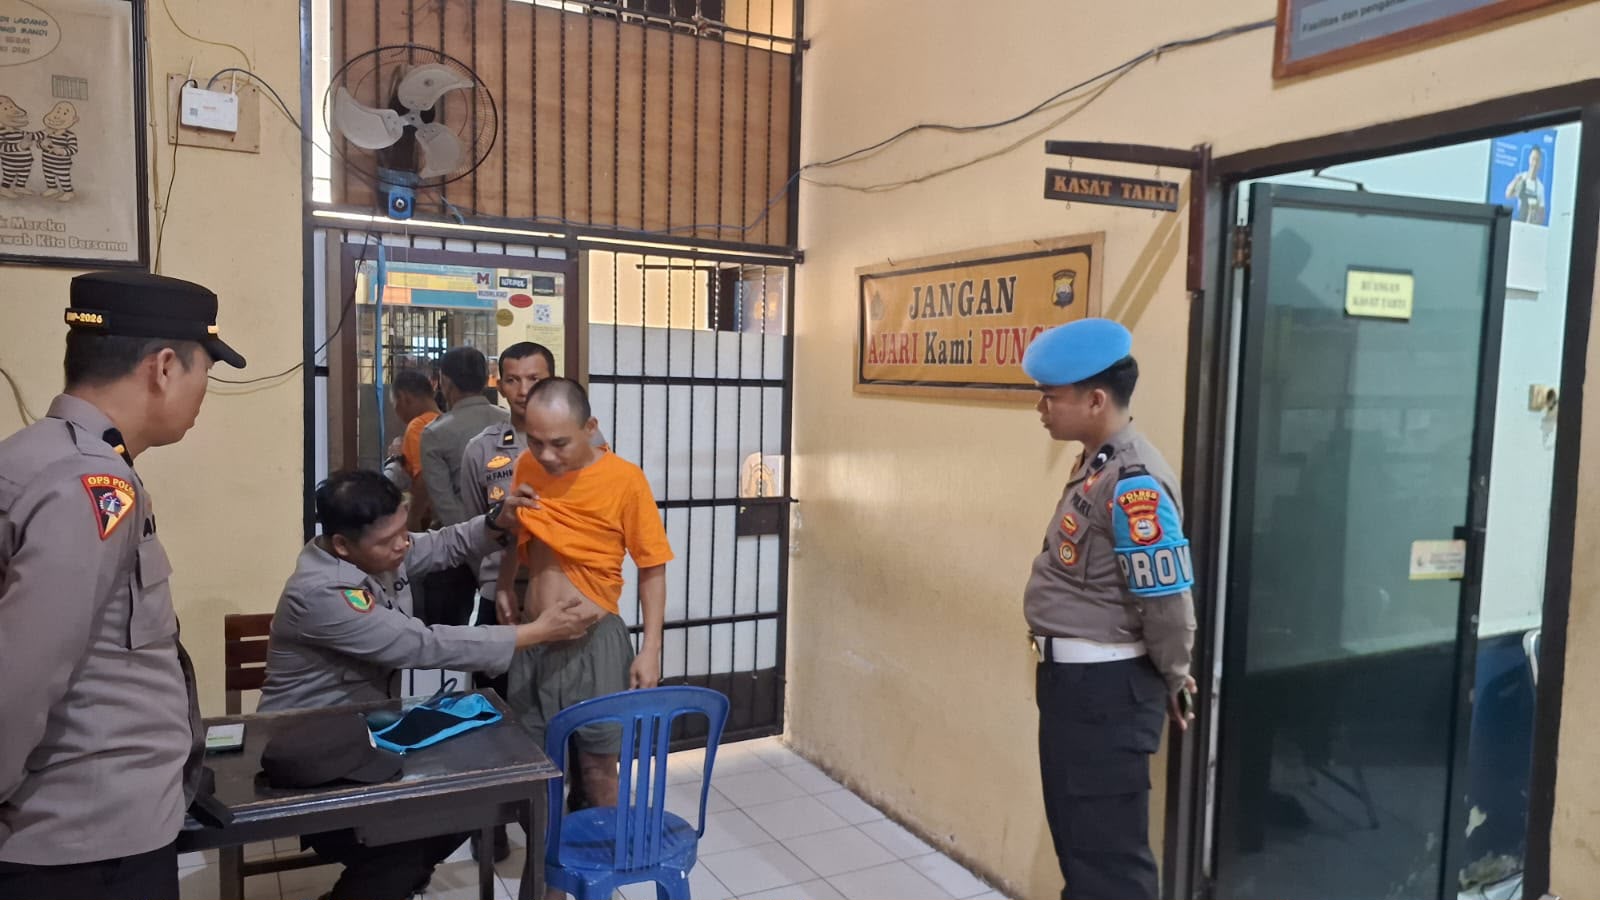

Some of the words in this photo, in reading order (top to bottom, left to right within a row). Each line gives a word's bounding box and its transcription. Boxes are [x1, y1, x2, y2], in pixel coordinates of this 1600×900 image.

[1053, 175, 1112, 197] KASAT
[1120, 183, 1175, 203] TAHTI
[11, 217, 66, 232] Mereka
[36, 234, 66, 248] Kita
[69, 236, 128, 252] Bersama
[477, 272, 490, 285] M
[909, 276, 1017, 320] JANGAN
[868, 332, 919, 365] AJARI
[924, 331, 973, 365] Kami
[979, 325, 1052, 365] PUN
[87, 476, 110, 485] OPS
[1071, 493, 1091, 517] POLRI
[1119, 490, 1157, 503] POLRES
